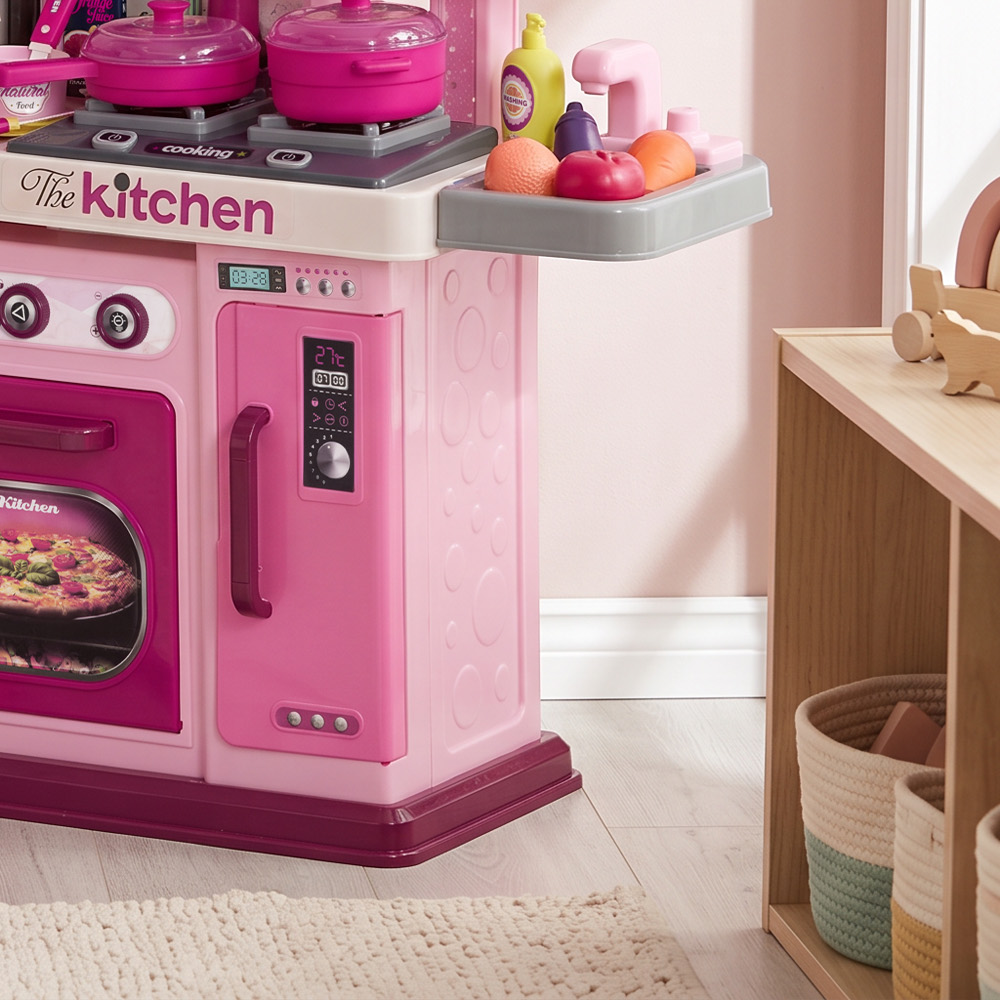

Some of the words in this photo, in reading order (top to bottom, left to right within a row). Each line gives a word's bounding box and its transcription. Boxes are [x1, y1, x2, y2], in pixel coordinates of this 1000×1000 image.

[16, 101, 34, 109] Food
[161, 143, 234, 159] cooking
[20, 168, 75, 209] The
[82, 171, 274, 235] kitchen
[232, 269, 267, 285] 03:28
